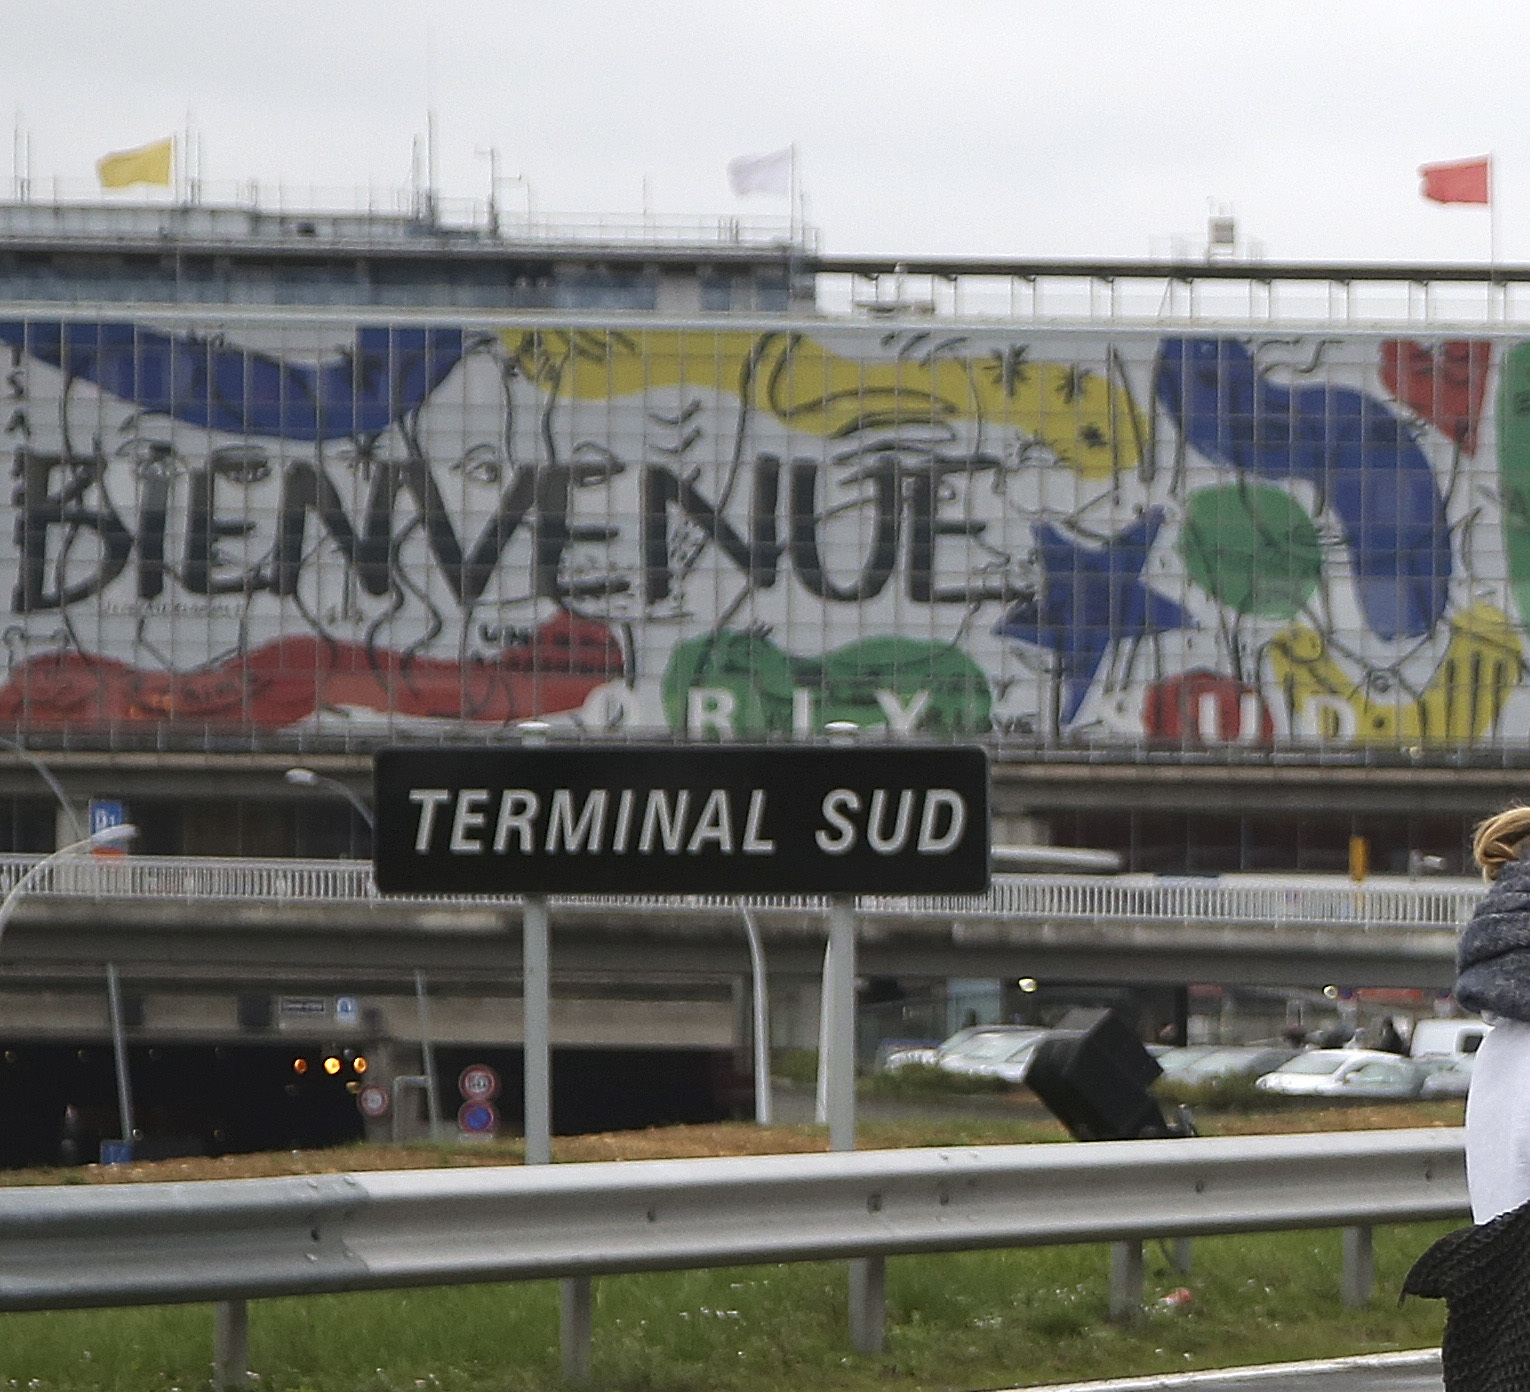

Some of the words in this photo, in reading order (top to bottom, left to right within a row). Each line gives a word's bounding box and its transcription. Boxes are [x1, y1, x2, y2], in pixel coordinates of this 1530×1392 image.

[12, 445, 1035, 612] BIENVENUE
[408, 788, 776, 853] TERMINAL
[814, 788, 966, 853] SUD
